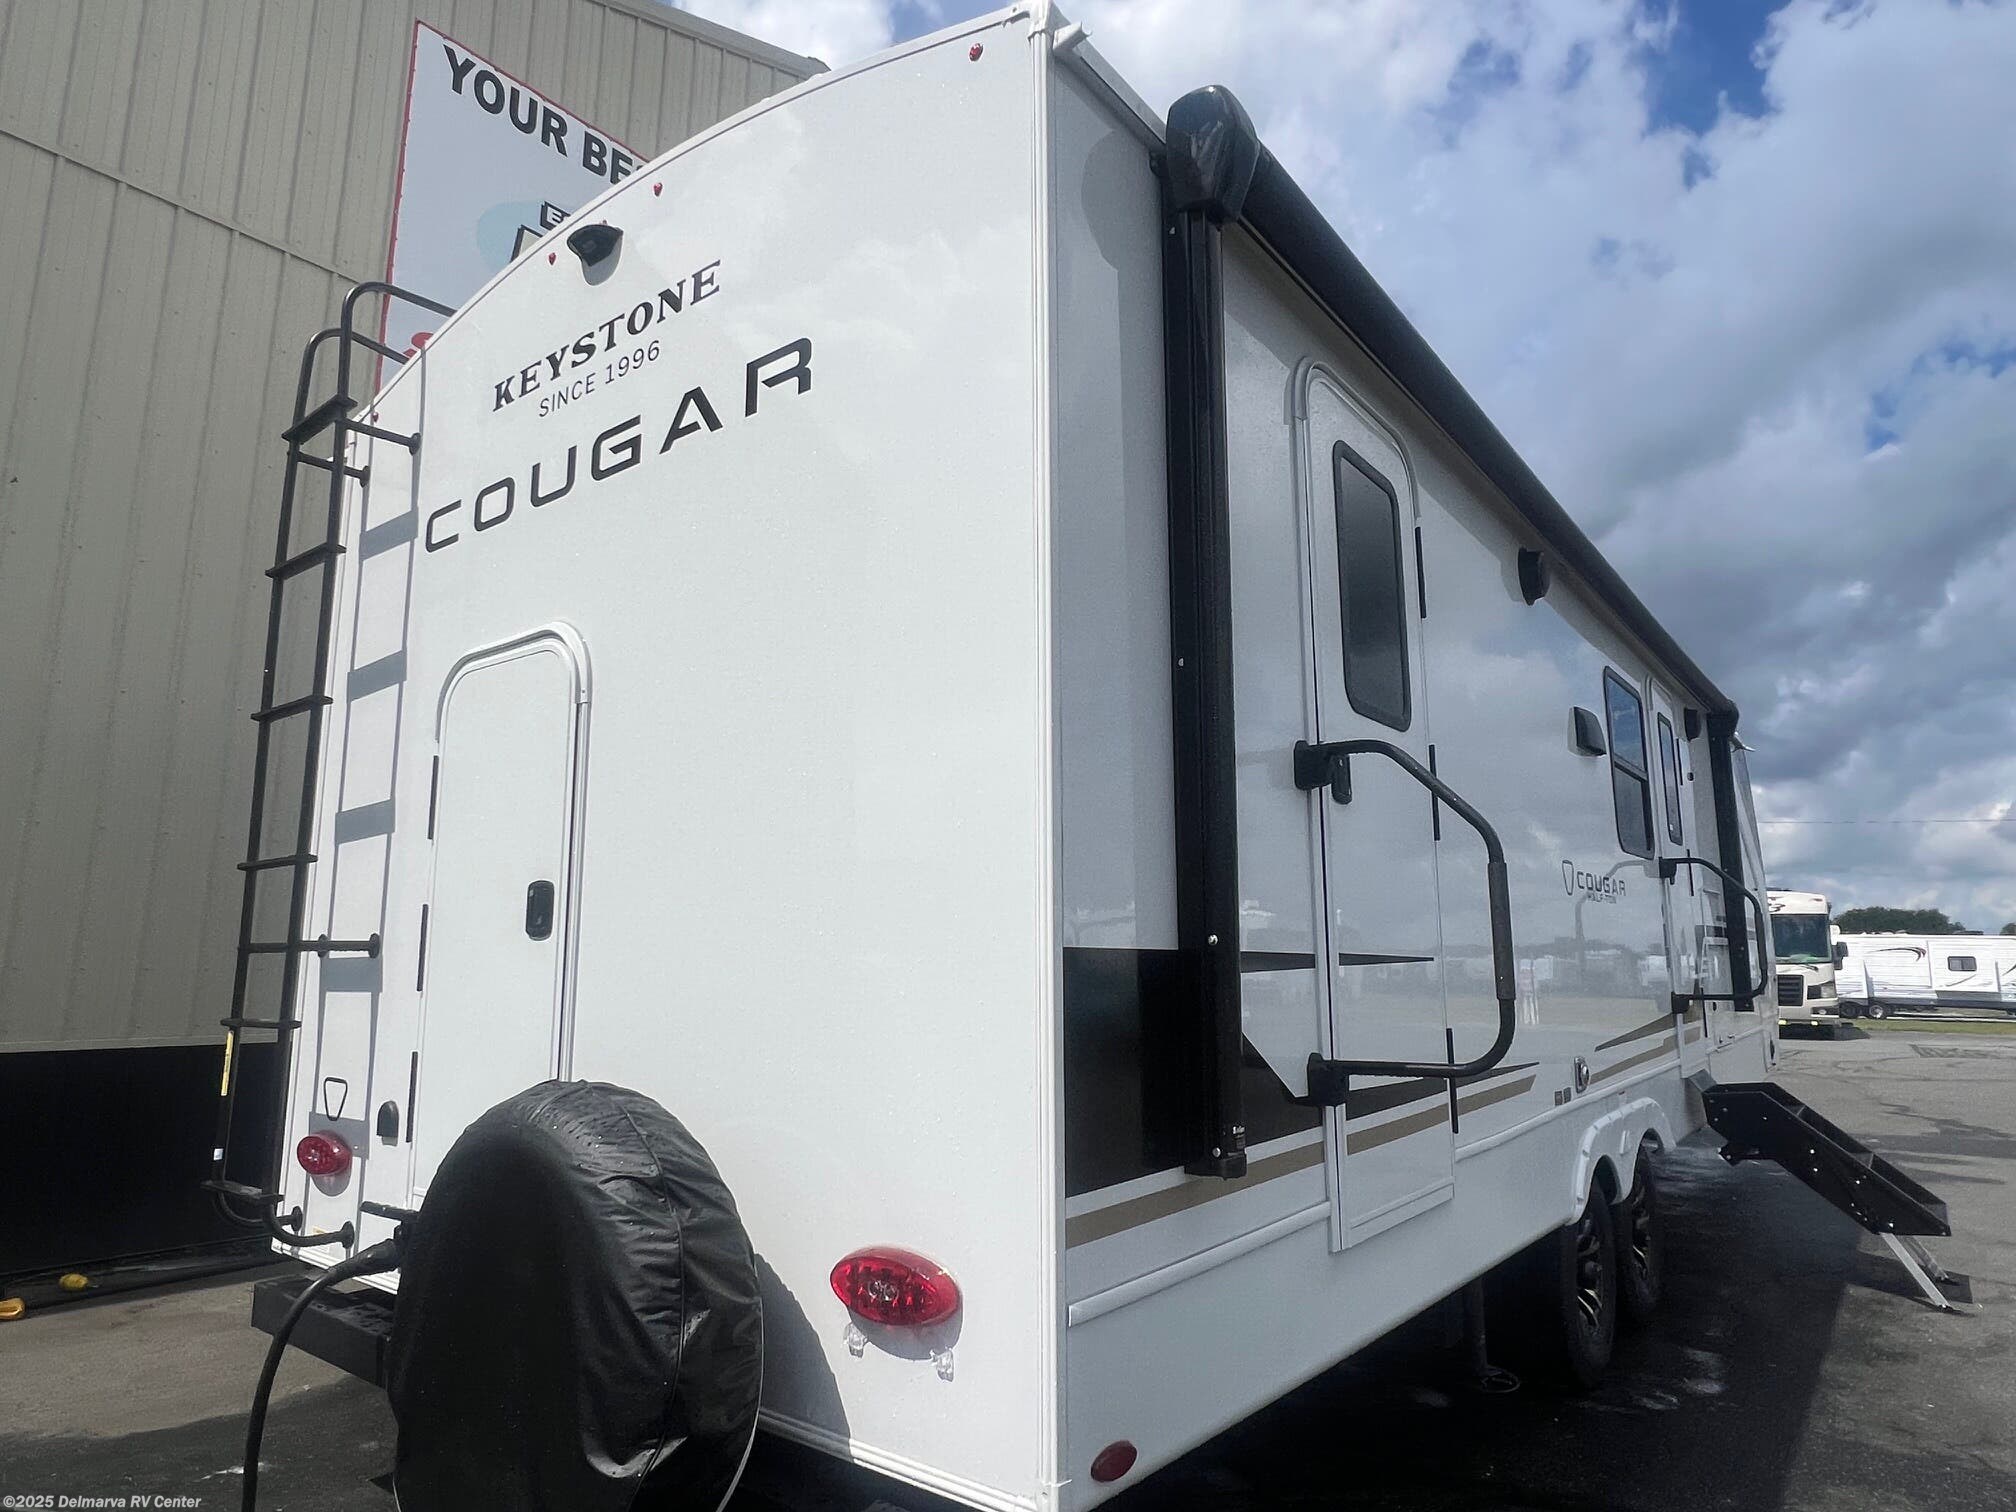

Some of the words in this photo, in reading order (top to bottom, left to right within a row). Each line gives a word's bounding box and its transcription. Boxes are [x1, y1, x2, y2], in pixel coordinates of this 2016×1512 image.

[443, 44, 568, 157] YOUR
[582, 130, 644, 185] BE
[493, 259, 721, 412] KEYSTONE
[539, 372, 597, 417] SINCE
[604, 339, 660, 384] 1996
[425, 337, 812, 553] COUGAR
[1576, 870, 1627, 896] COUGAR
